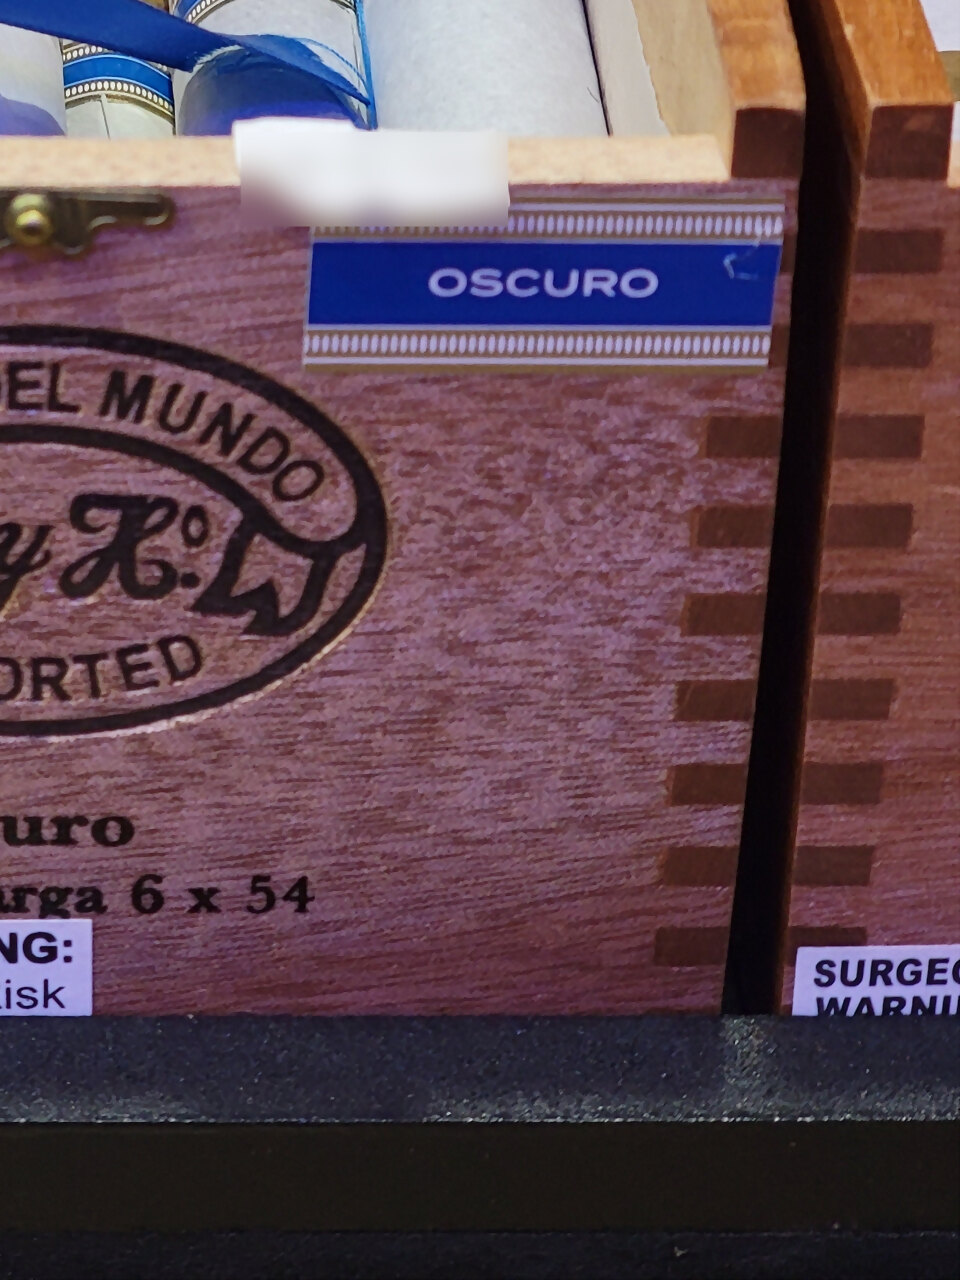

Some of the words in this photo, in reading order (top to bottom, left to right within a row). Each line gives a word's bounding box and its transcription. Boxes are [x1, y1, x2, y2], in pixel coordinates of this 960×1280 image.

[428, 267, 660, 300] OSCURO
[99, 370, 326, 502] MUNDO
[131, 874, 165, 915] 6
[187, 885, 222, 915] x
[248, 874, 315, 915] 54
[815, 994, 960, 1016] WARNI
